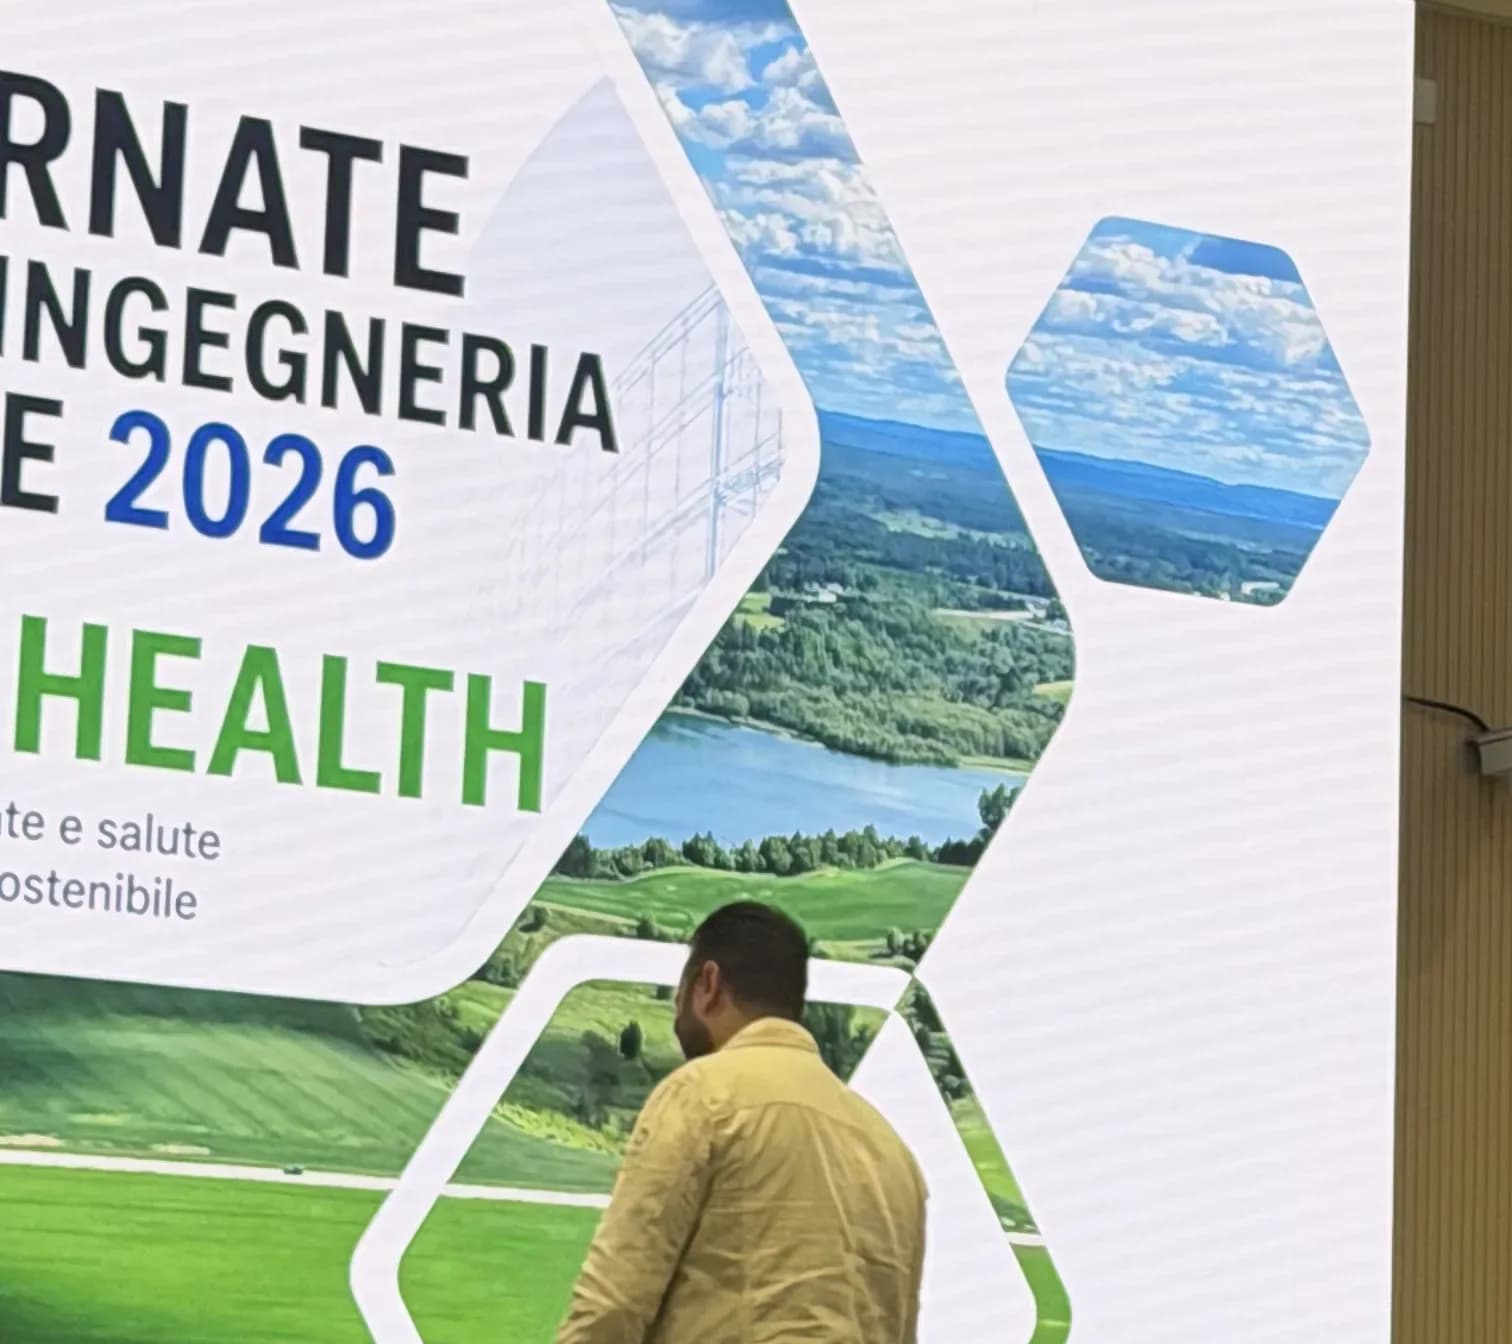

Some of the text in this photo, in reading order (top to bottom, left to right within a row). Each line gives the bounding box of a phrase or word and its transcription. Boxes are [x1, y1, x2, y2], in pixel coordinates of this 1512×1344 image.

[0, 69, 470, 299] RNATE
[0, 391, 397, 562] E 2026
[13, 613, 548, 814] HEALTH
[0, 800, 220, 860] te e salute
[0, 869, 198, 920] ostenibile
